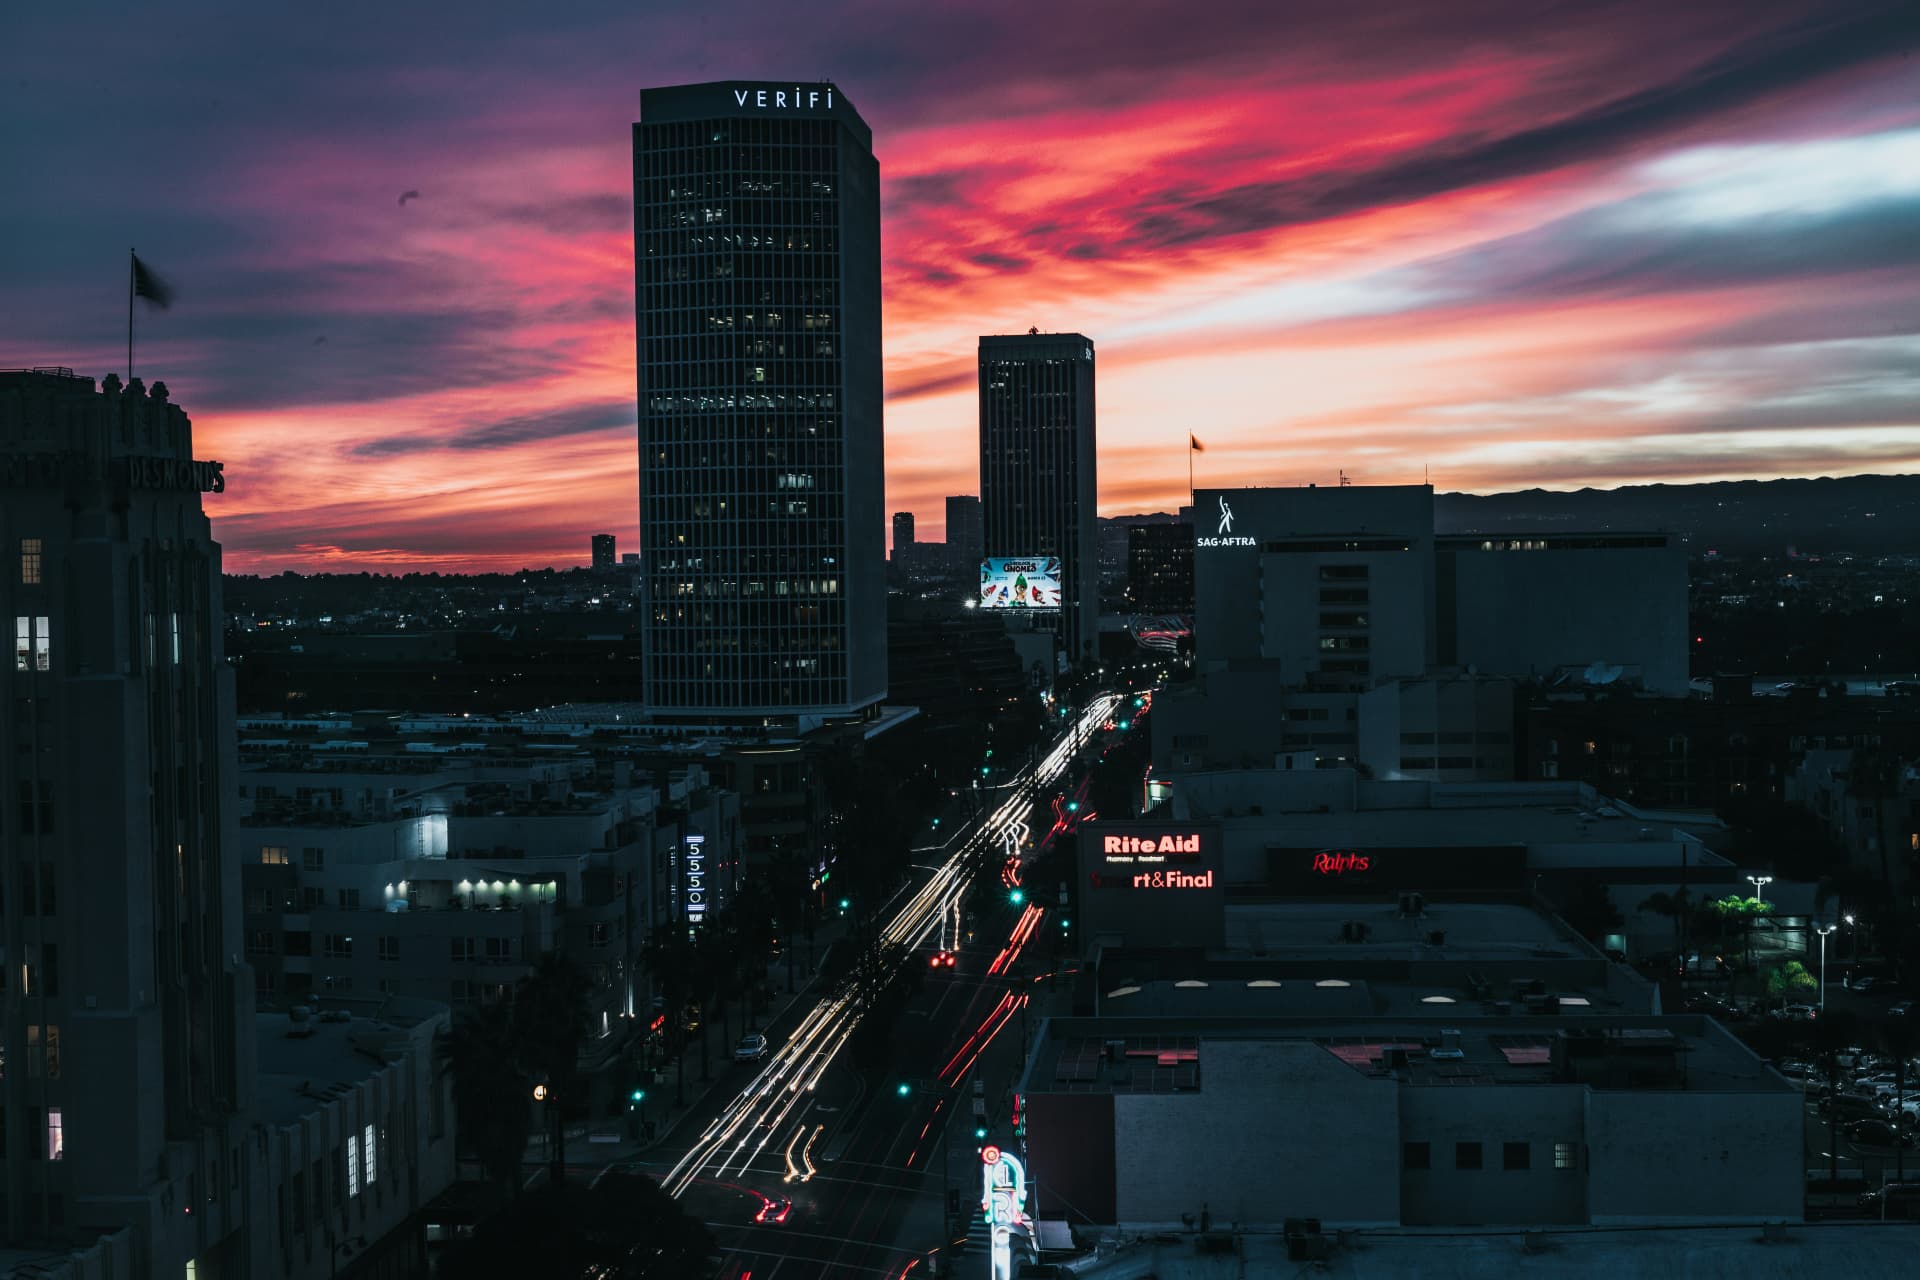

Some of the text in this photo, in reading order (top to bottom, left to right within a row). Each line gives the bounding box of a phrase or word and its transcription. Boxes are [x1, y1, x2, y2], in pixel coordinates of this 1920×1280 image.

[1104, 834, 1200, 853] Rite Aid
[1312, 852, 1370, 875] Ralphs
